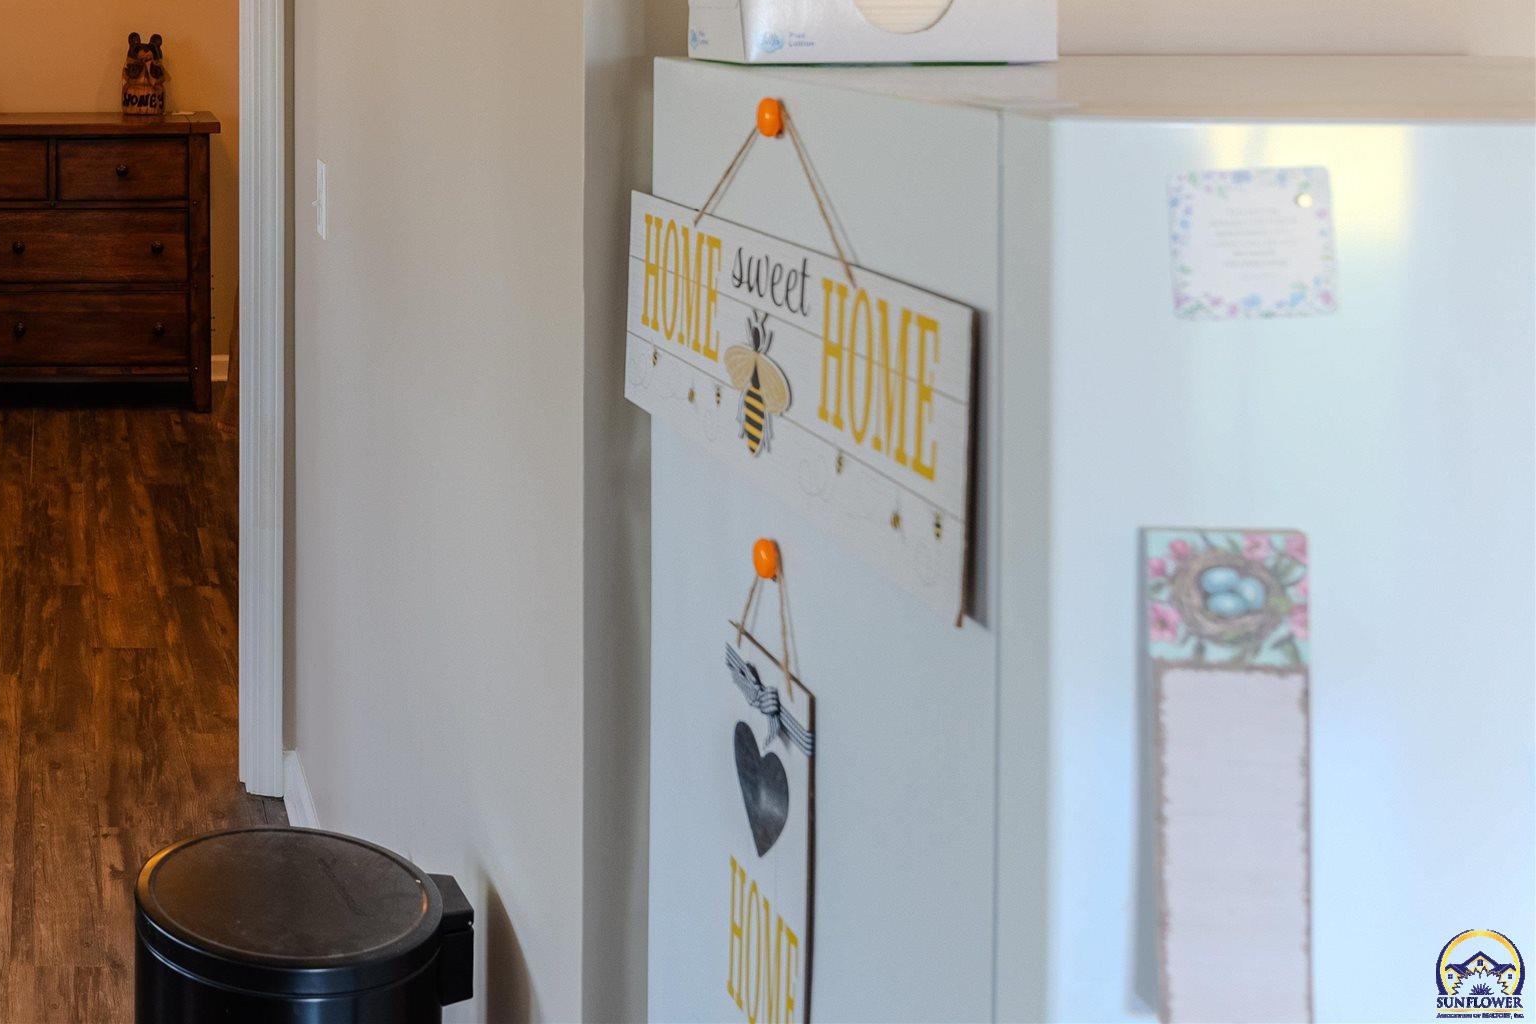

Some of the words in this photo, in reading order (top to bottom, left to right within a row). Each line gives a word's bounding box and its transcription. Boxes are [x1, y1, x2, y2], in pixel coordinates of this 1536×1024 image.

[123, 92, 164, 109] HONEY
[641, 213, 722, 363] HOME
[732, 247, 811, 317] sweet
[818, 278, 940, 482] HOME
